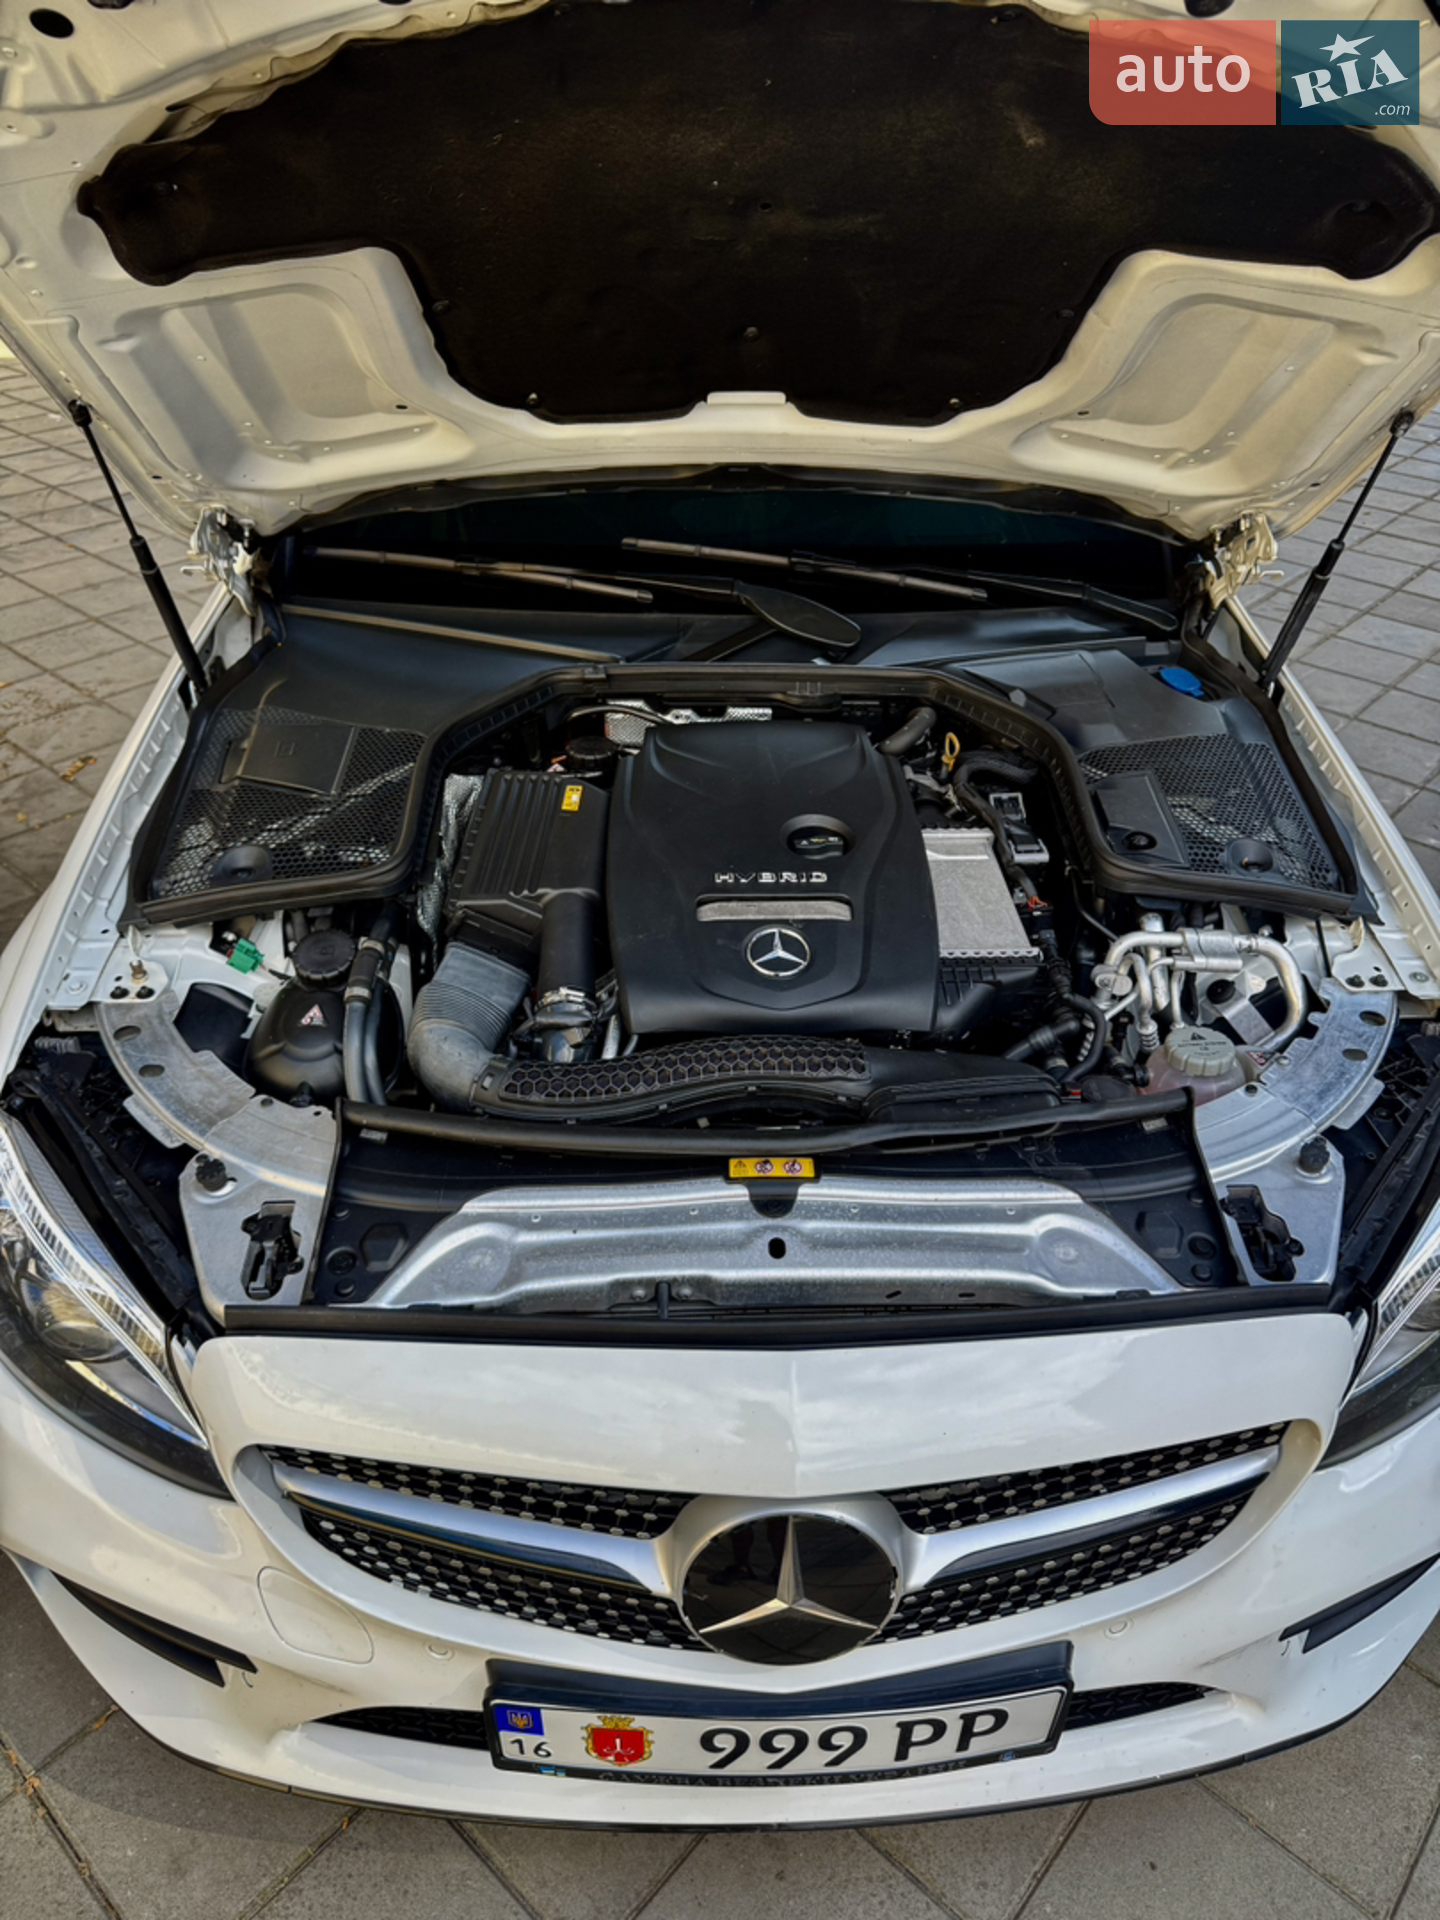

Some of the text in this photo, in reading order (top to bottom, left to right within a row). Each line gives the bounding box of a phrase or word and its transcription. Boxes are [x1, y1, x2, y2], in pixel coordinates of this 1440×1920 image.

[714, 871, 828, 883] HYBRID
[509, 1738, 552, 1758] 16
[700, 1725, 868, 1769] 999
